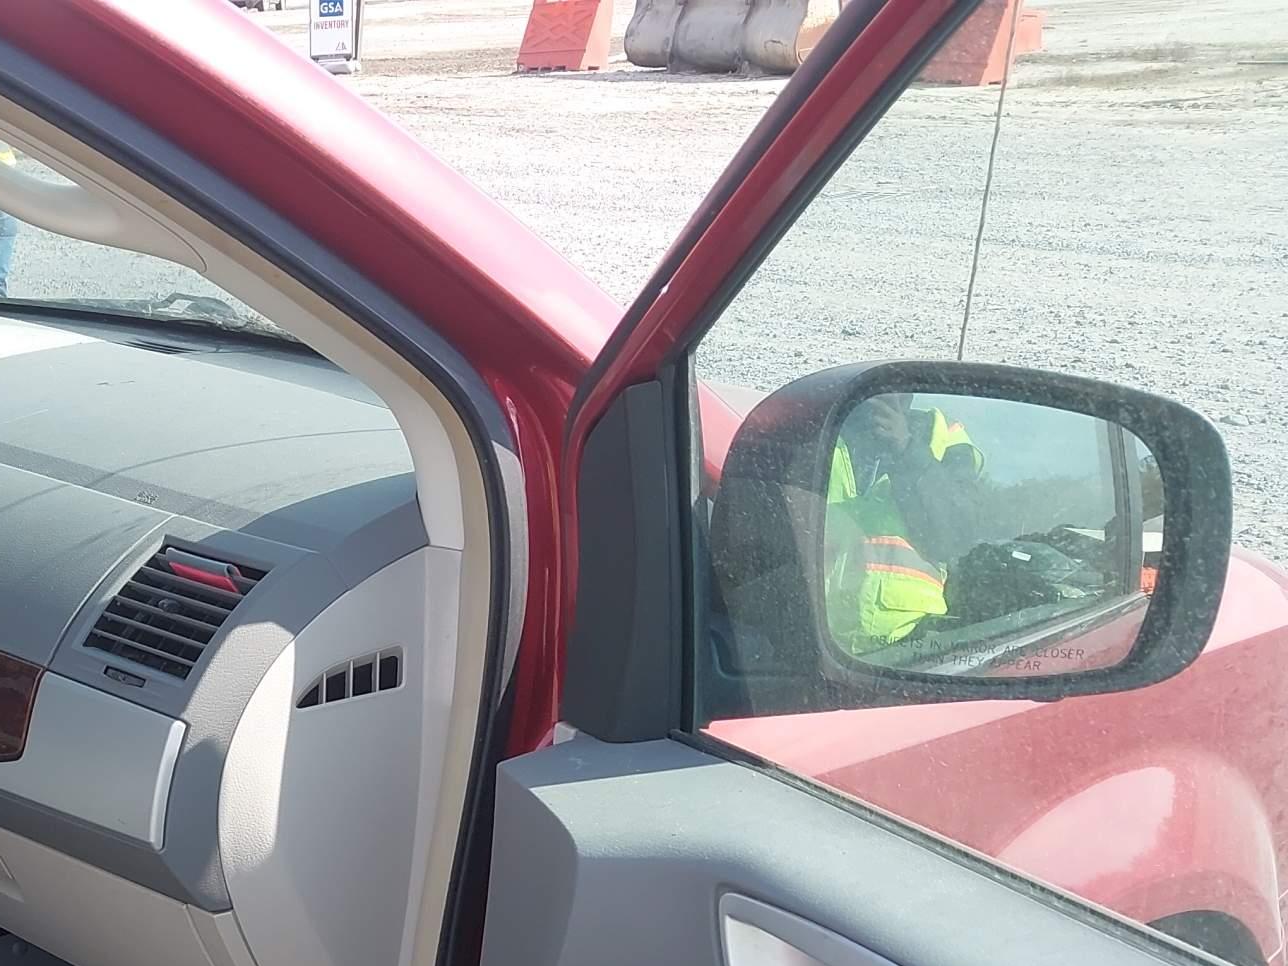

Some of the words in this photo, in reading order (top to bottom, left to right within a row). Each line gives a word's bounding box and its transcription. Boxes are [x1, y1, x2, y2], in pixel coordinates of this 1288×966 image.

[320, 2, 343, 13] GSA
[313, 20, 349, 30] INVENTORY
[870, 635, 924, 648] OBJECTS
[929, 640, 942, 649] IN
[1035, 647, 1085, 660] CLOSER
[952, 655, 985, 667] THEY
